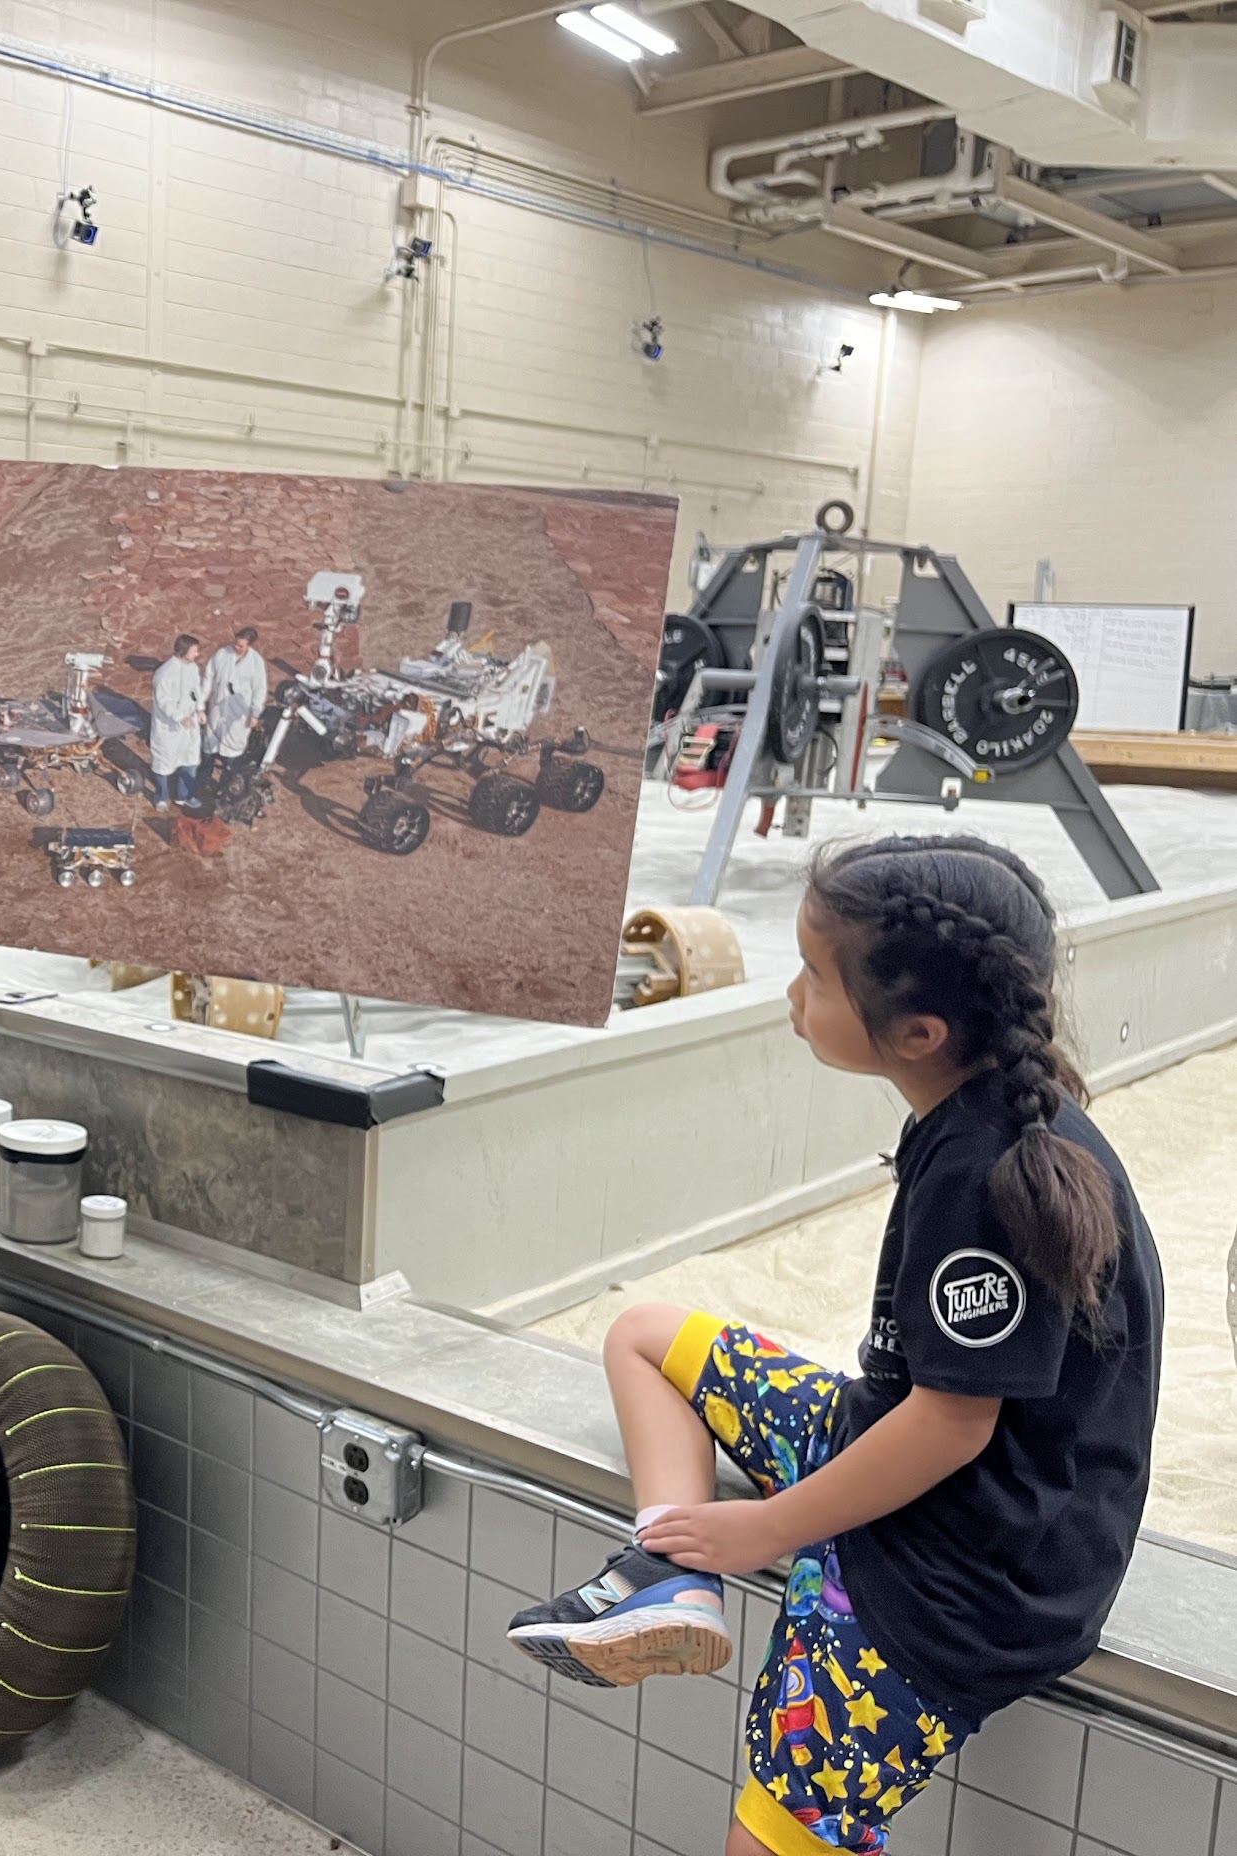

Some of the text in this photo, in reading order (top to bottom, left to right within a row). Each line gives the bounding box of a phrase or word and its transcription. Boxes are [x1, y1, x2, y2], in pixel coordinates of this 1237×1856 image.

[941, 660, 978, 745] BARBELL
[943, 1271, 1009, 1324] FUTURE
[953, 1300, 1009, 1322] ENGINEERS
